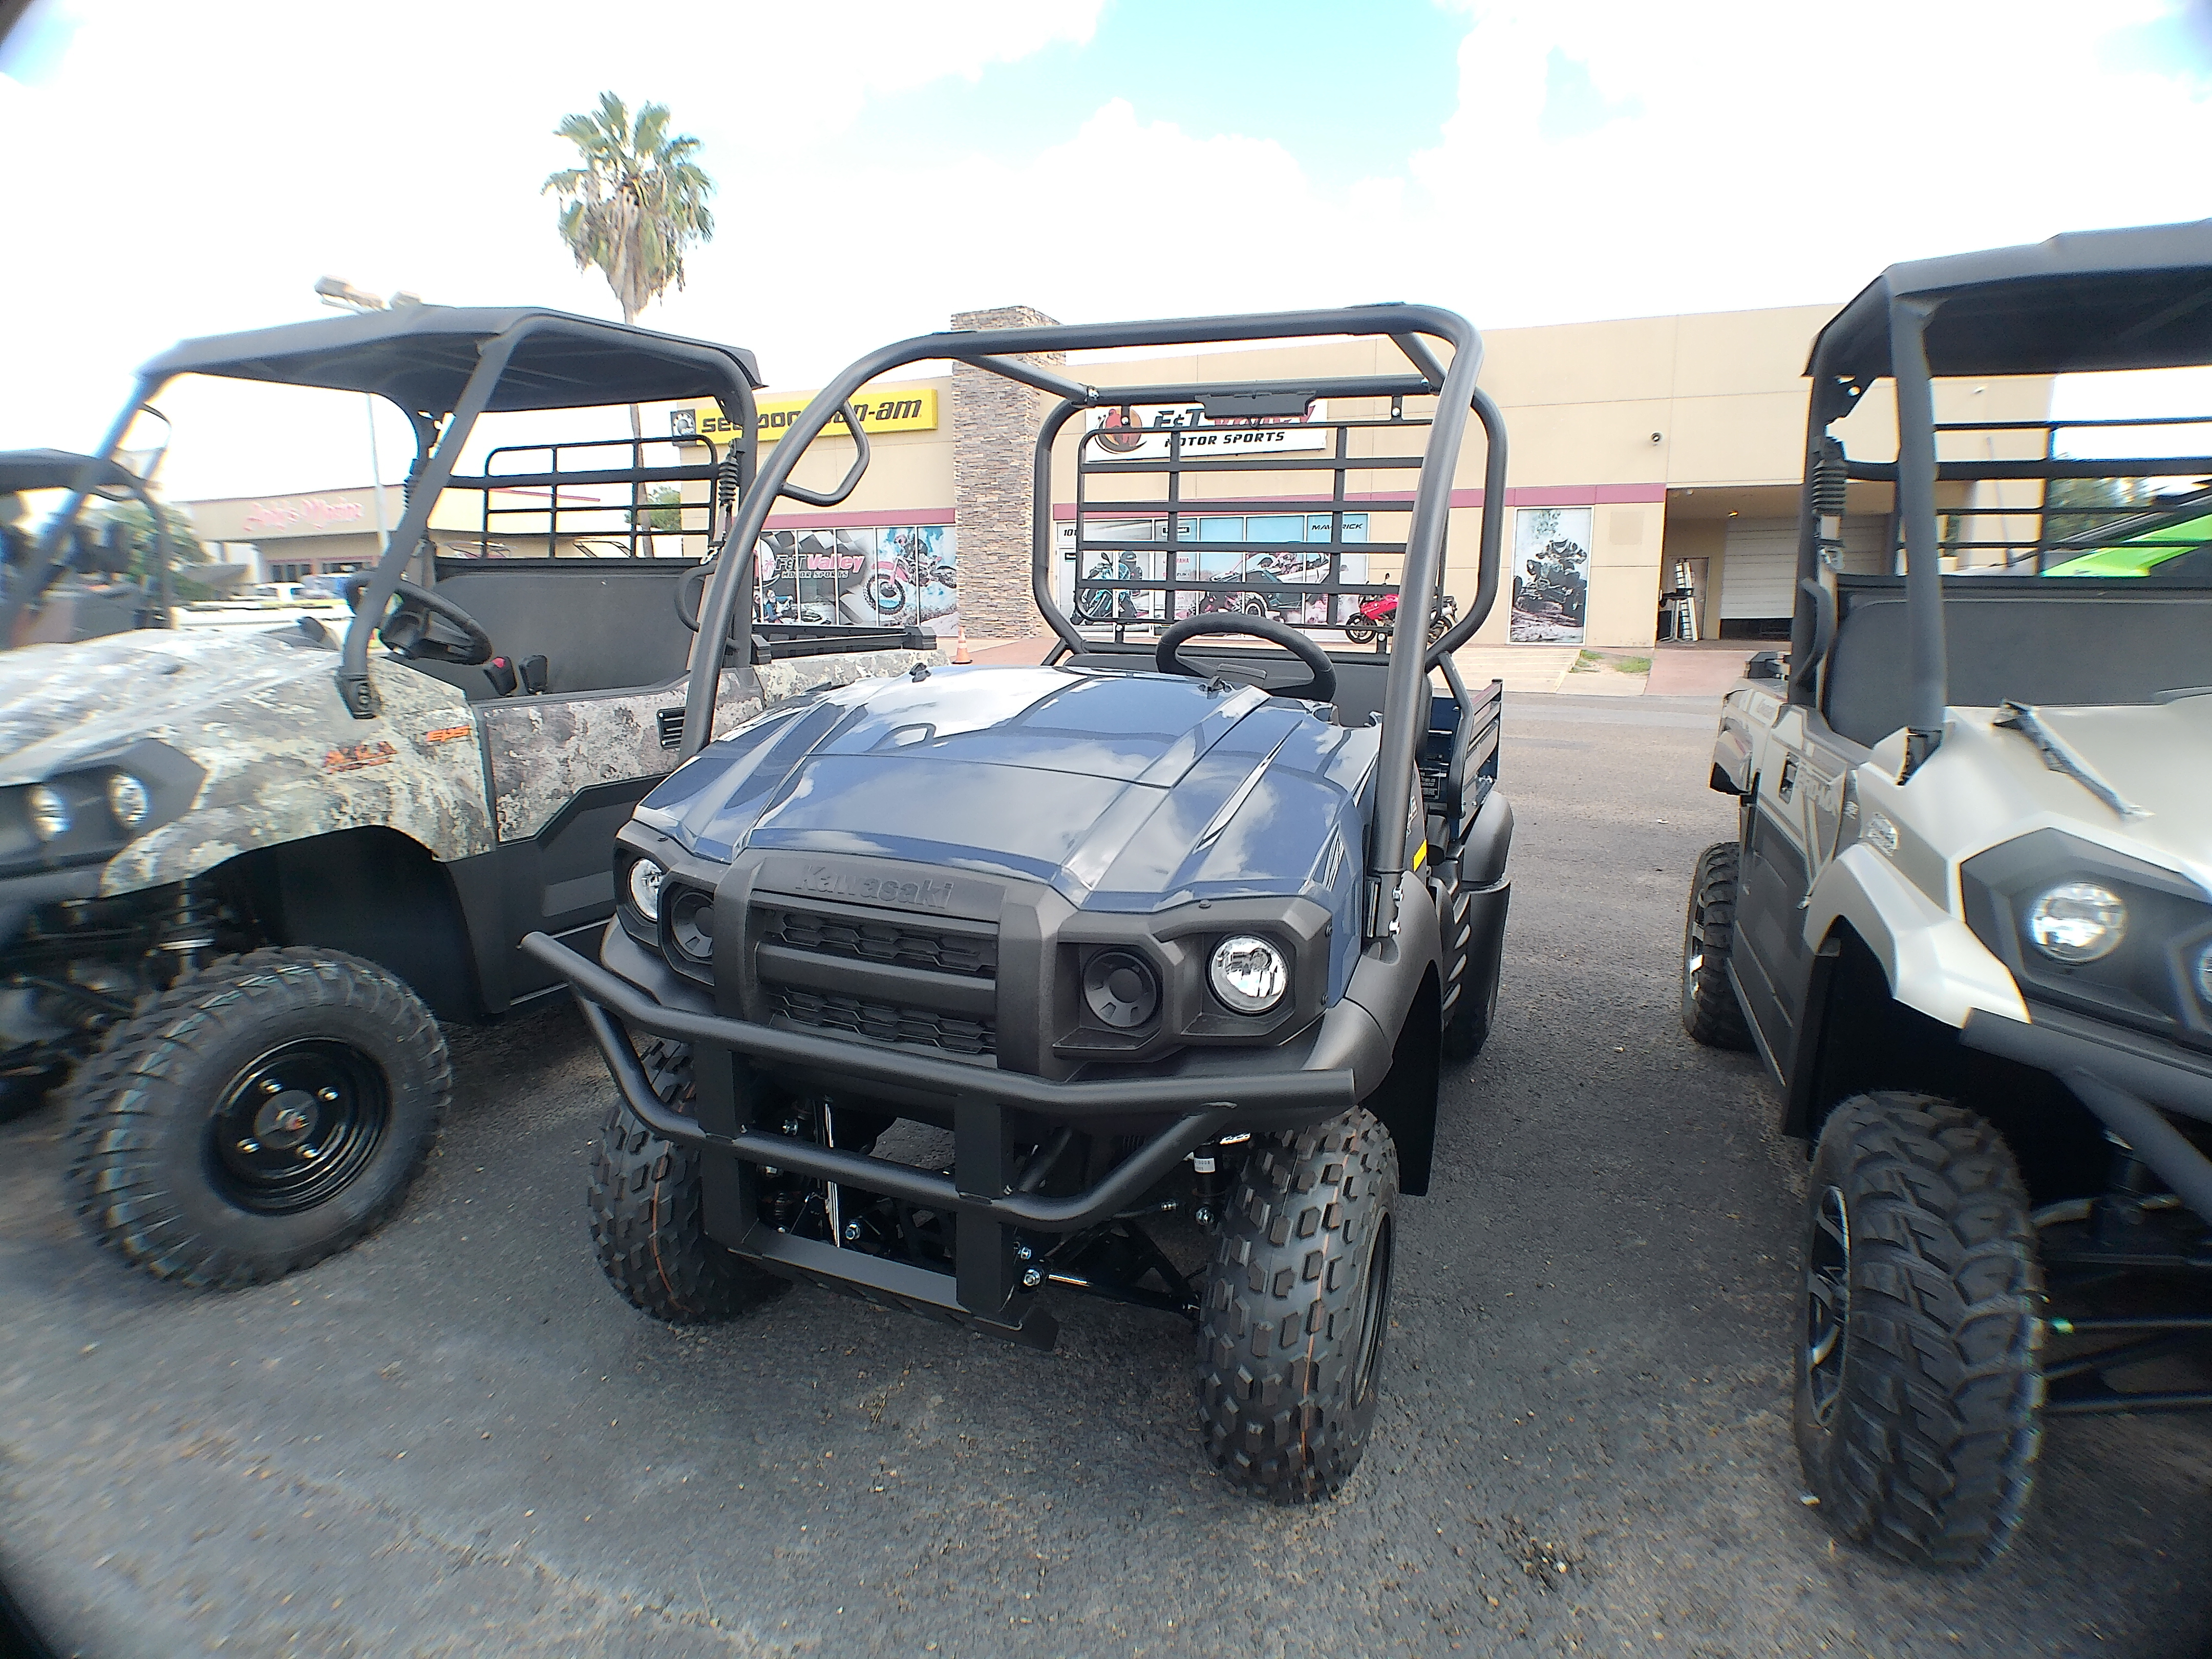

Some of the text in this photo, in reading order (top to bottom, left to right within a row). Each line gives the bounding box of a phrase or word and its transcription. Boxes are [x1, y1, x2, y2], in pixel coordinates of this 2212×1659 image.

[819, 399, 922, 424] n-am
[1223, 432, 1285, 445] SPORTS
[807, 553, 865, 573] Valley
[781, 570, 812, 579] MOOR
[795, 864, 955, 909] Kawasaki
